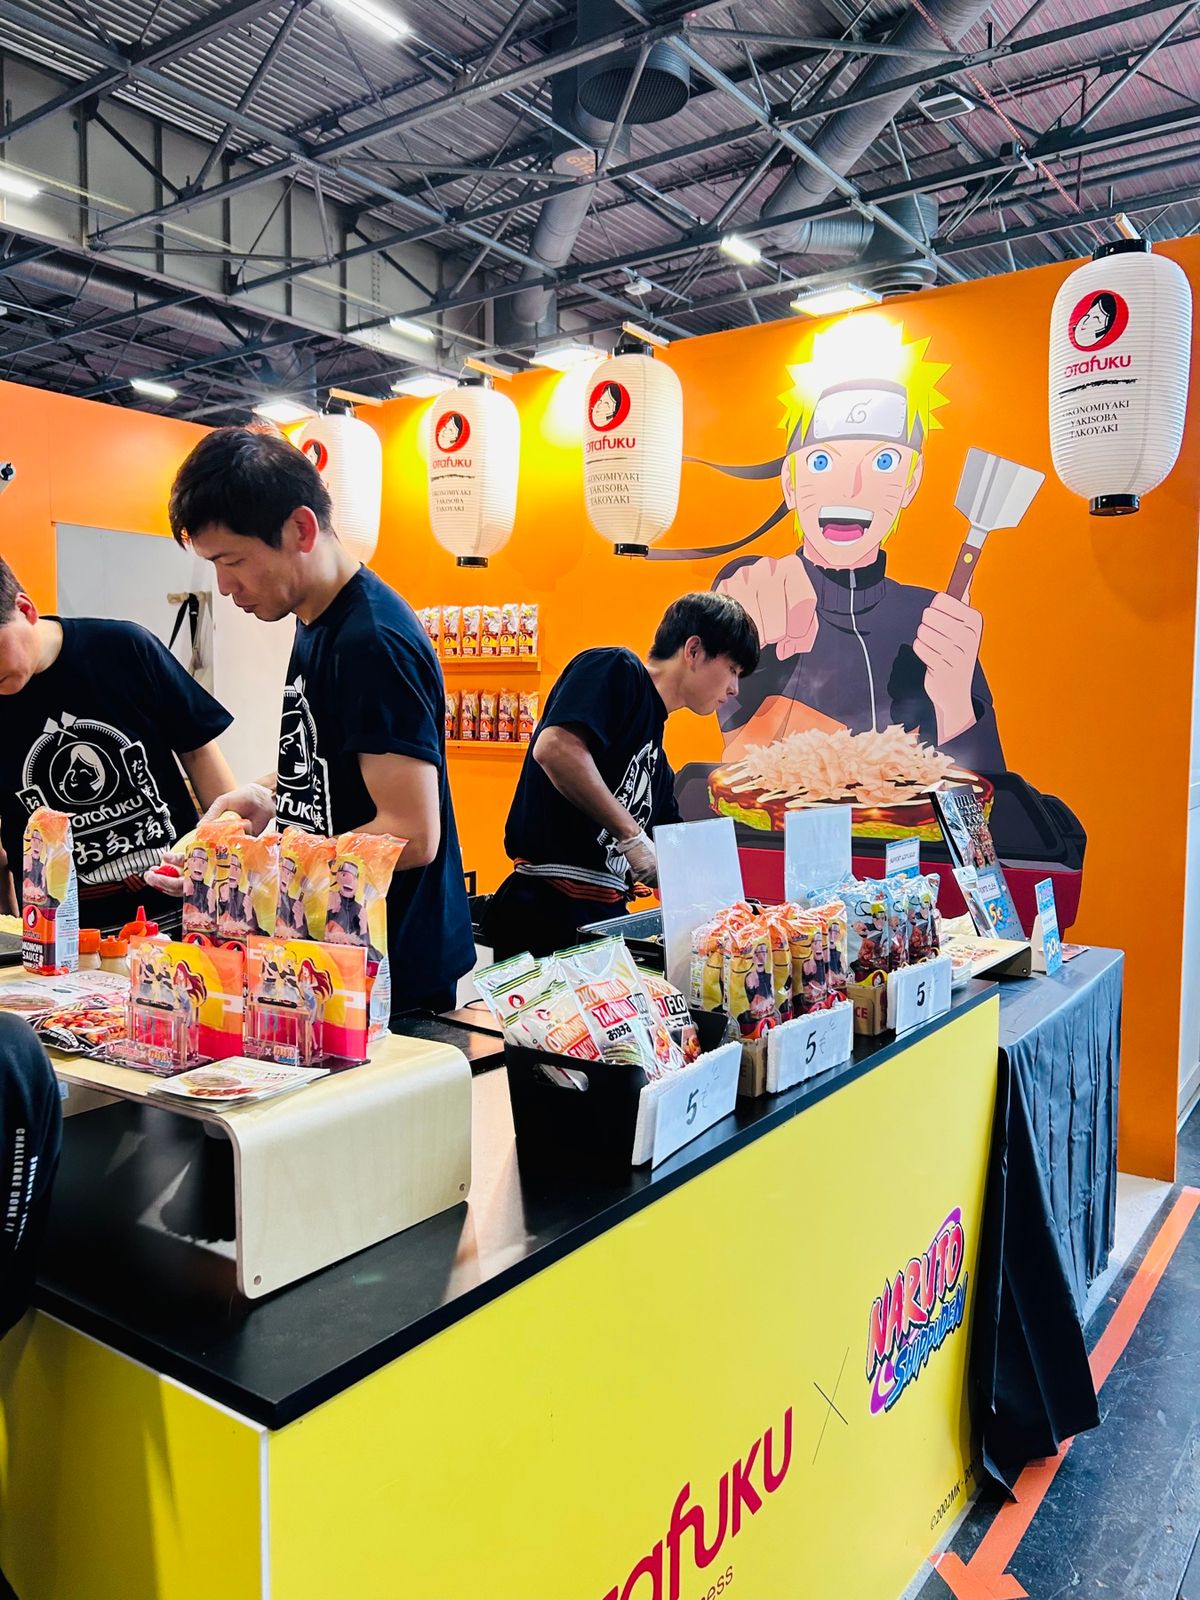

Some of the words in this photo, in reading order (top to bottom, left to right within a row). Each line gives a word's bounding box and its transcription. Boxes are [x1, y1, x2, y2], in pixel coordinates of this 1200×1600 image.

[1070, 413, 1118, 427] YAKISOBA
[6, 1191, 21, 1218] DONE
[866, 1221, 964, 1383] NARUTO
[883, 1270, 969, 1414] SHIPPUDEN
